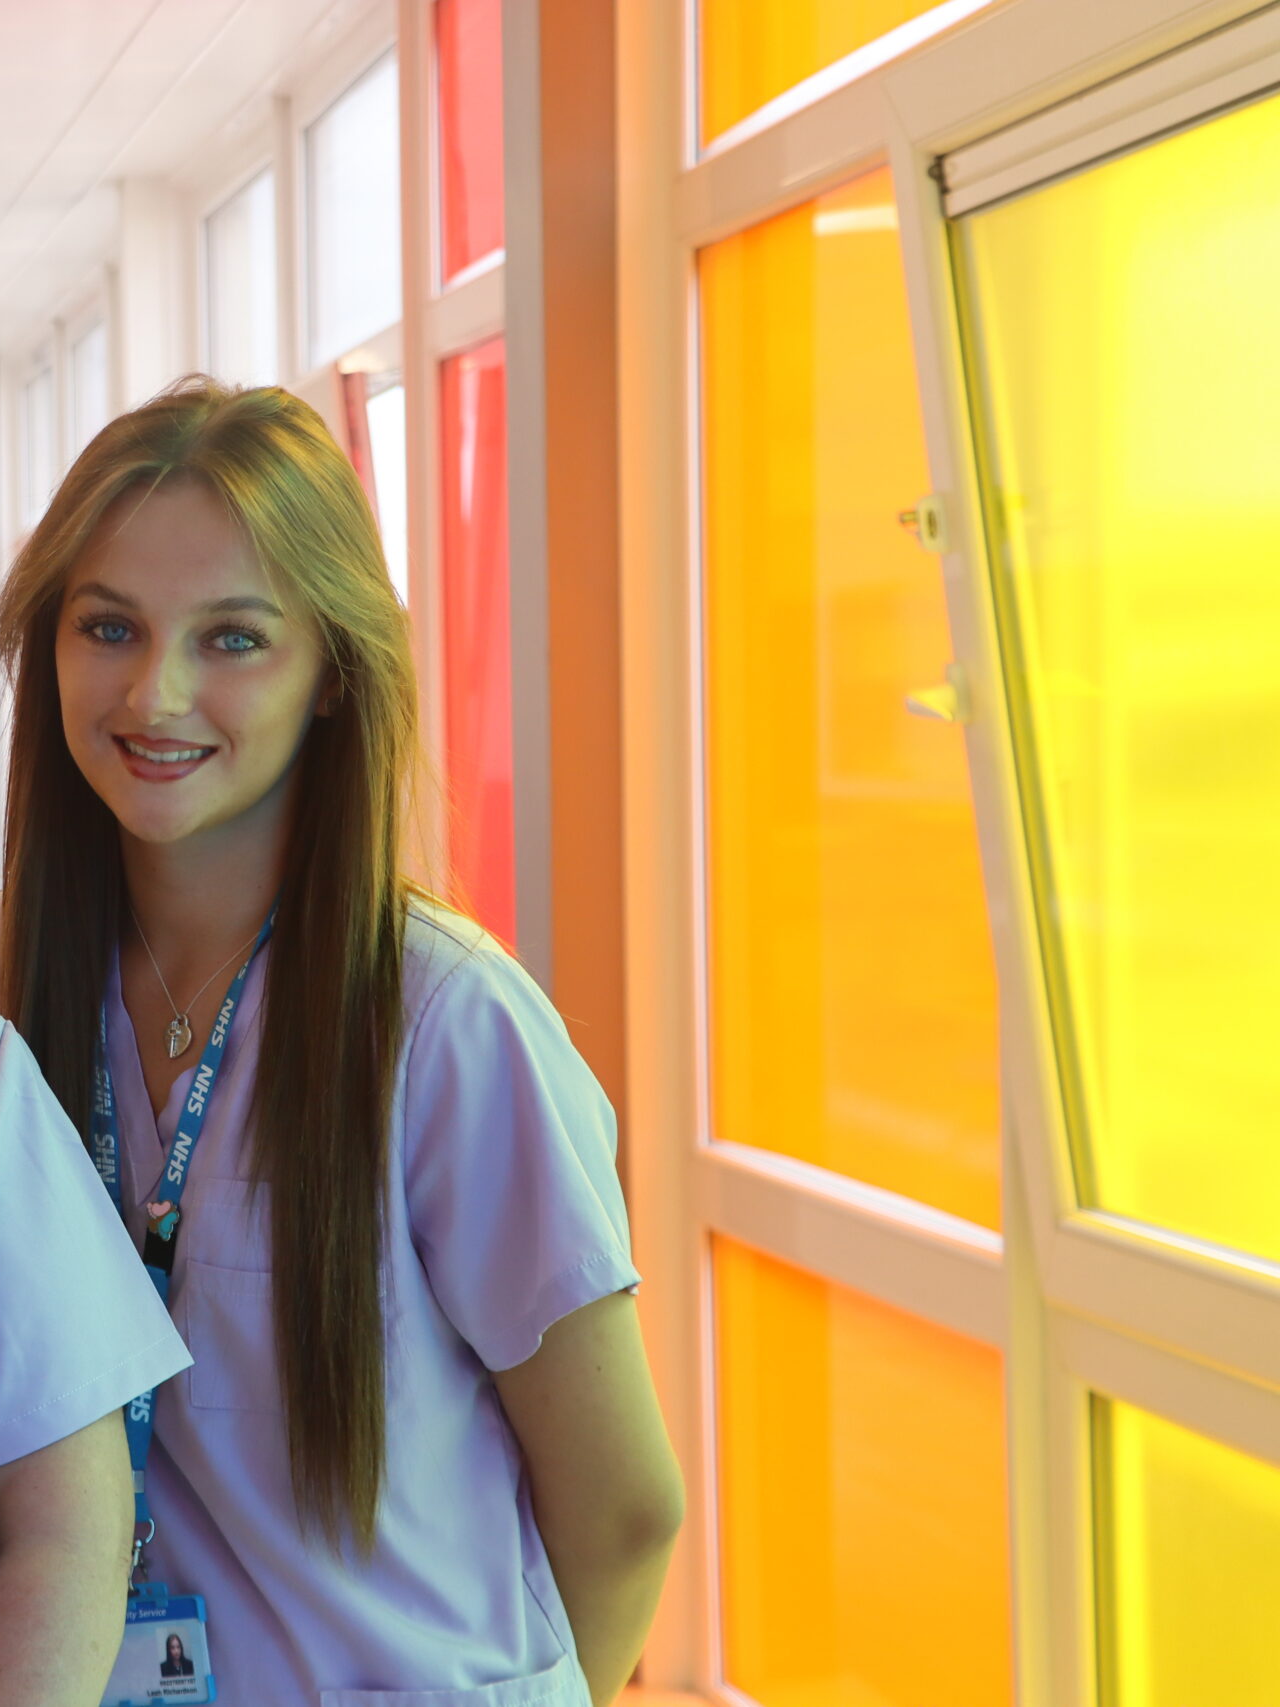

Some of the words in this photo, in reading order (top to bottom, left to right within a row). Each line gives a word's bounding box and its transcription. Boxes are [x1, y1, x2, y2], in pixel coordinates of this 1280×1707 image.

[211, 998, 234, 1048] NHS
[188, 1064, 214, 1117] NHS
[95, 1133, 117, 1184] NHS
[167, 1131, 193, 1186] NHS
[130, 1388, 152, 1424] HS
[139, 1608, 167, 1618] Service
